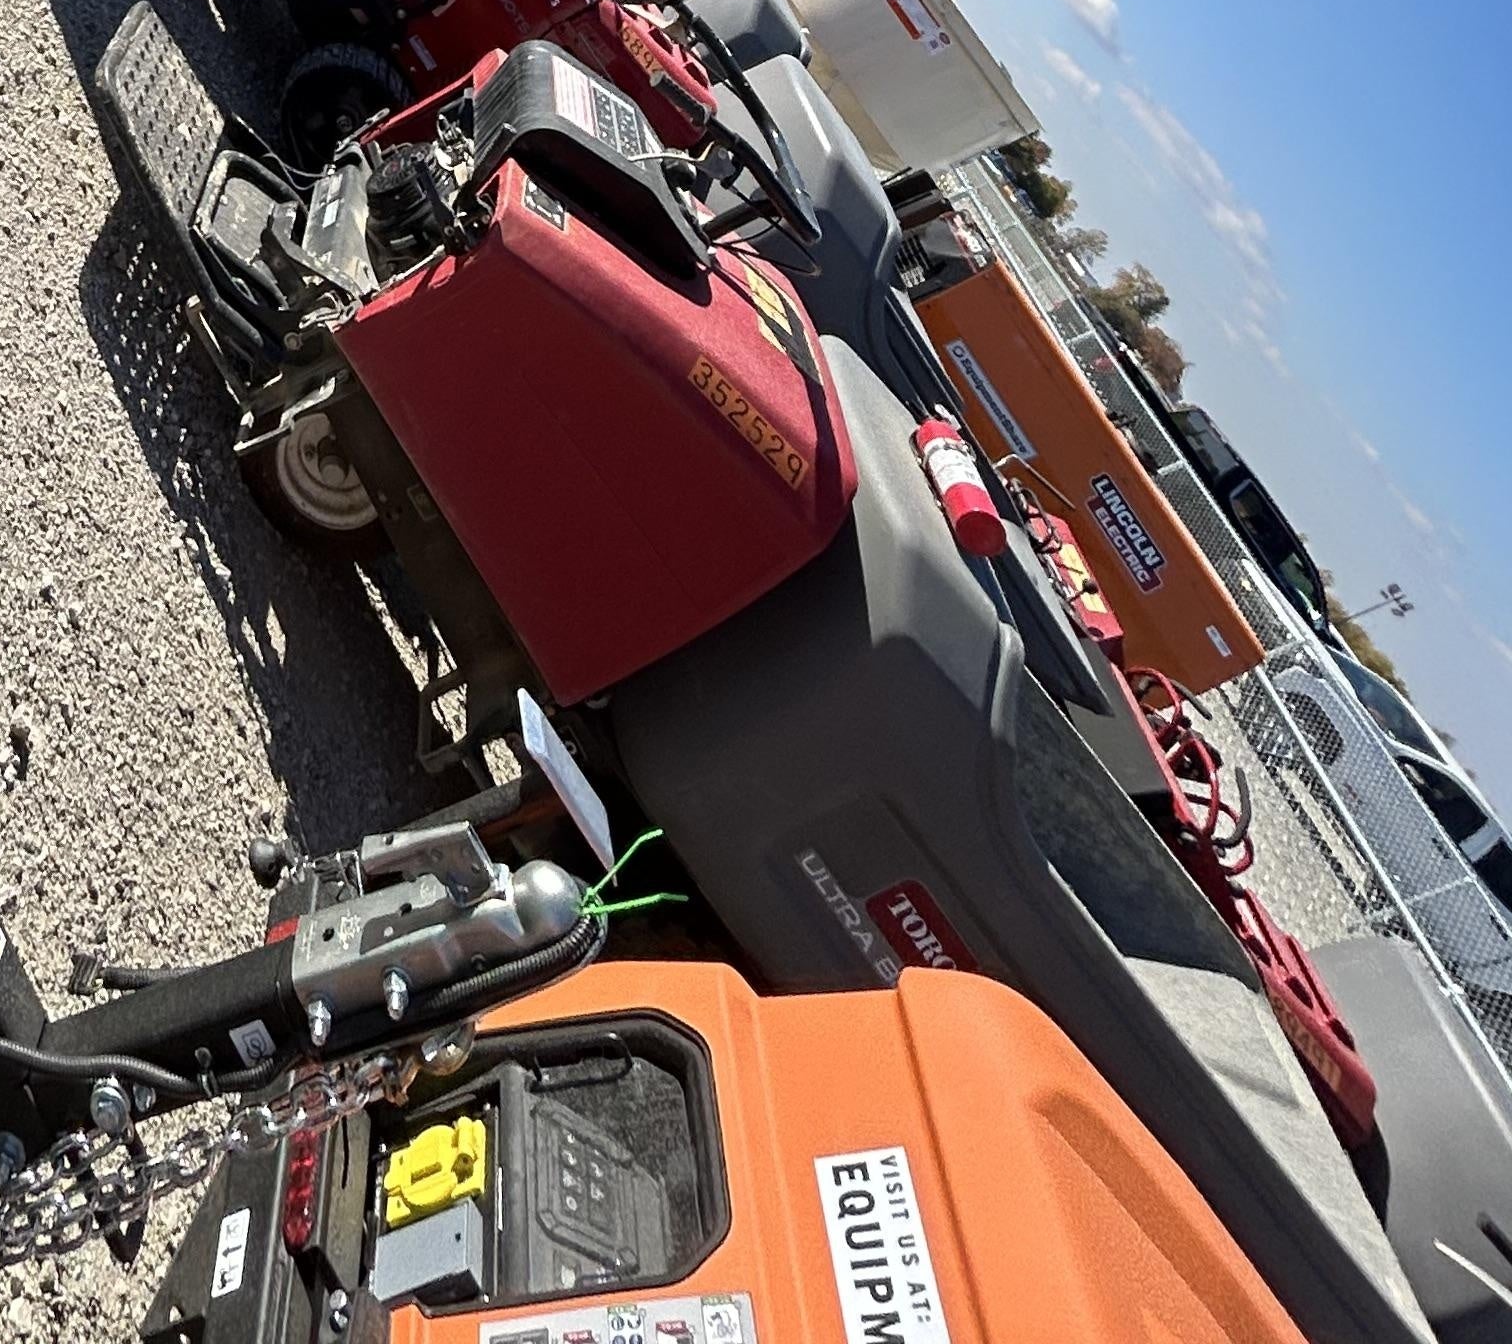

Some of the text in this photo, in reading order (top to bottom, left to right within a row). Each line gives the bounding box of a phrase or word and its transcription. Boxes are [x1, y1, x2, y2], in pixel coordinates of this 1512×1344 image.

[693, 362, 804, 484] 352529
[1093, 478, 1162, 567] LINCOLN
[1094, 508, 1152, 585] ELECTRIC
[802, 852, 874, 954] ULTRA
[880, 1155, 909, 1220] VISIT
[897, 1233, 920, 1267] US
